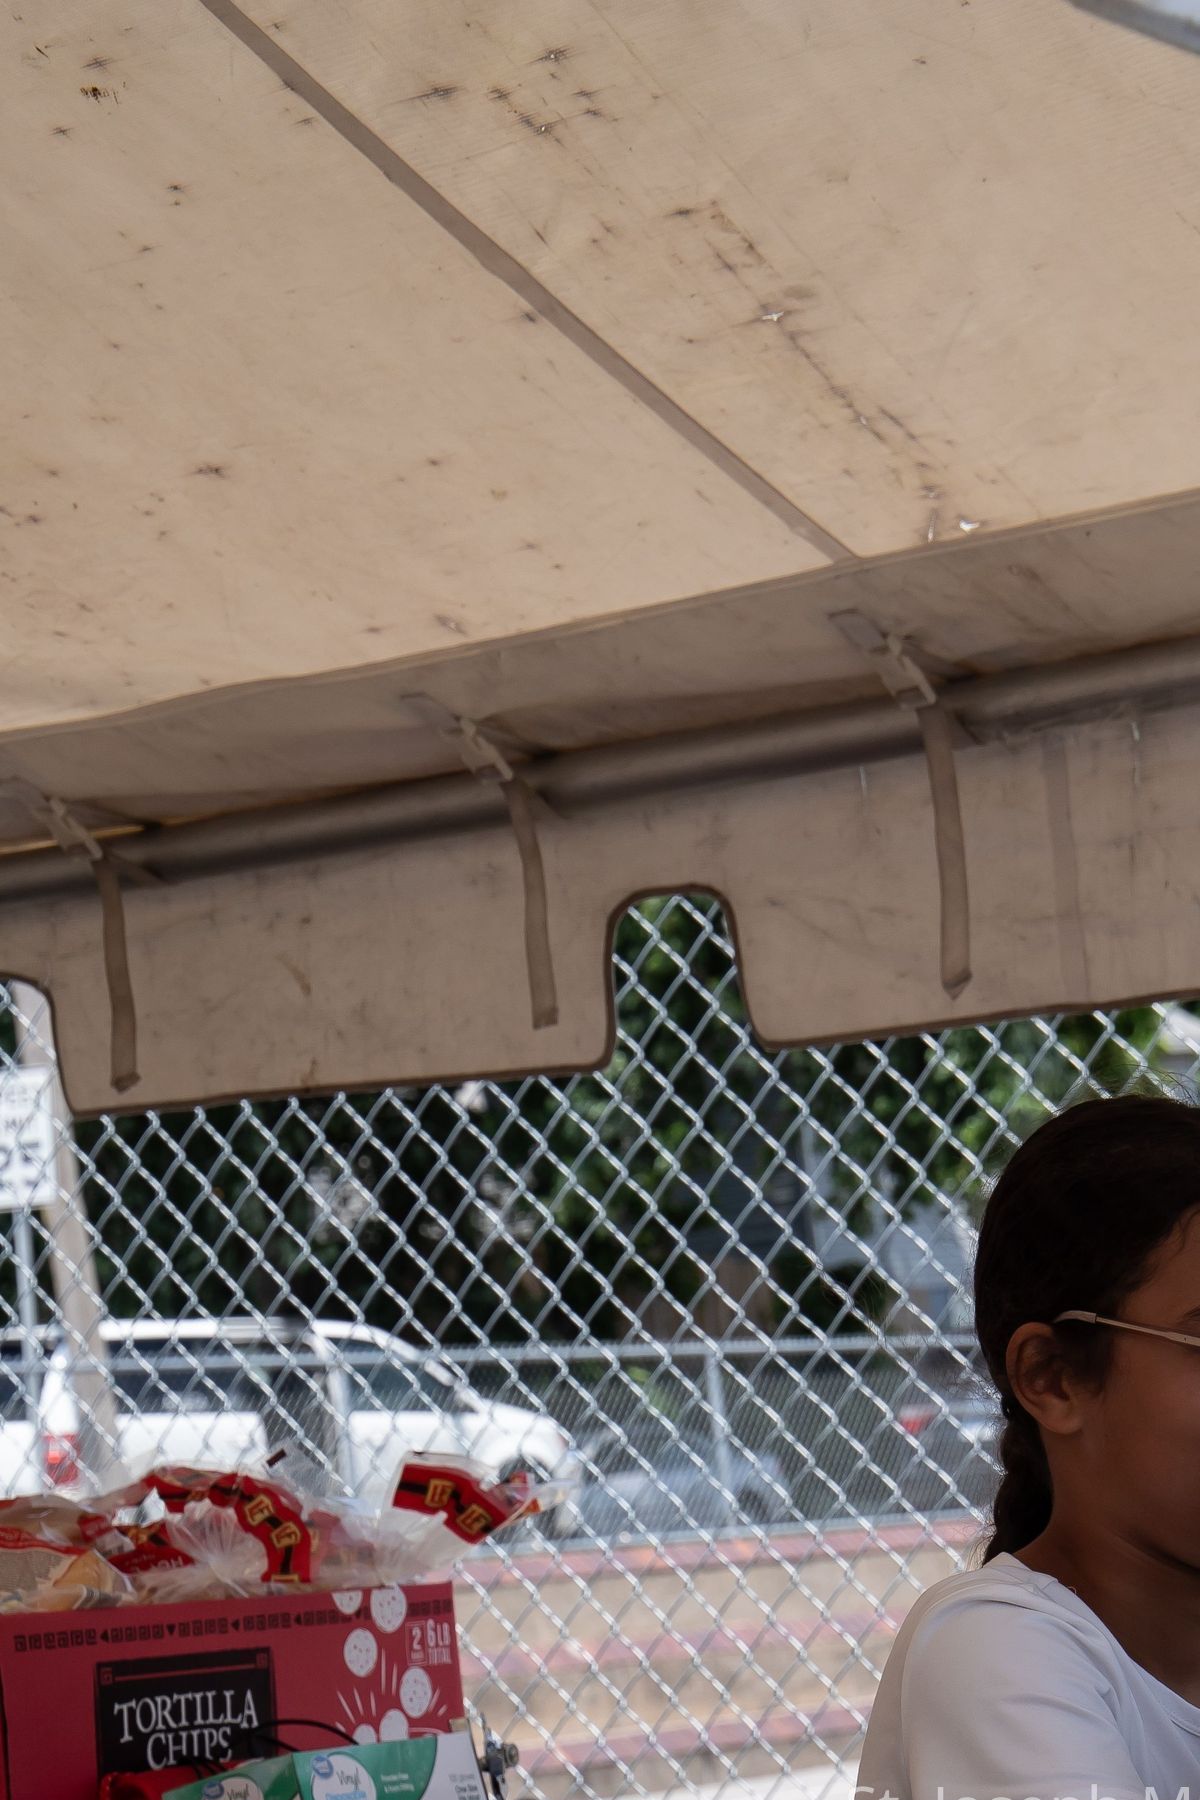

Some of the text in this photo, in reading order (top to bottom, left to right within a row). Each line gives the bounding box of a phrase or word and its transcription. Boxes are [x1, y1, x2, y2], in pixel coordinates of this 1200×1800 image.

[113, 1688, 260, 1744] TORTILLA
[146, 1726, 232, 1771] CHIPS
[336, 1767, 361, 1791] Vinyl
